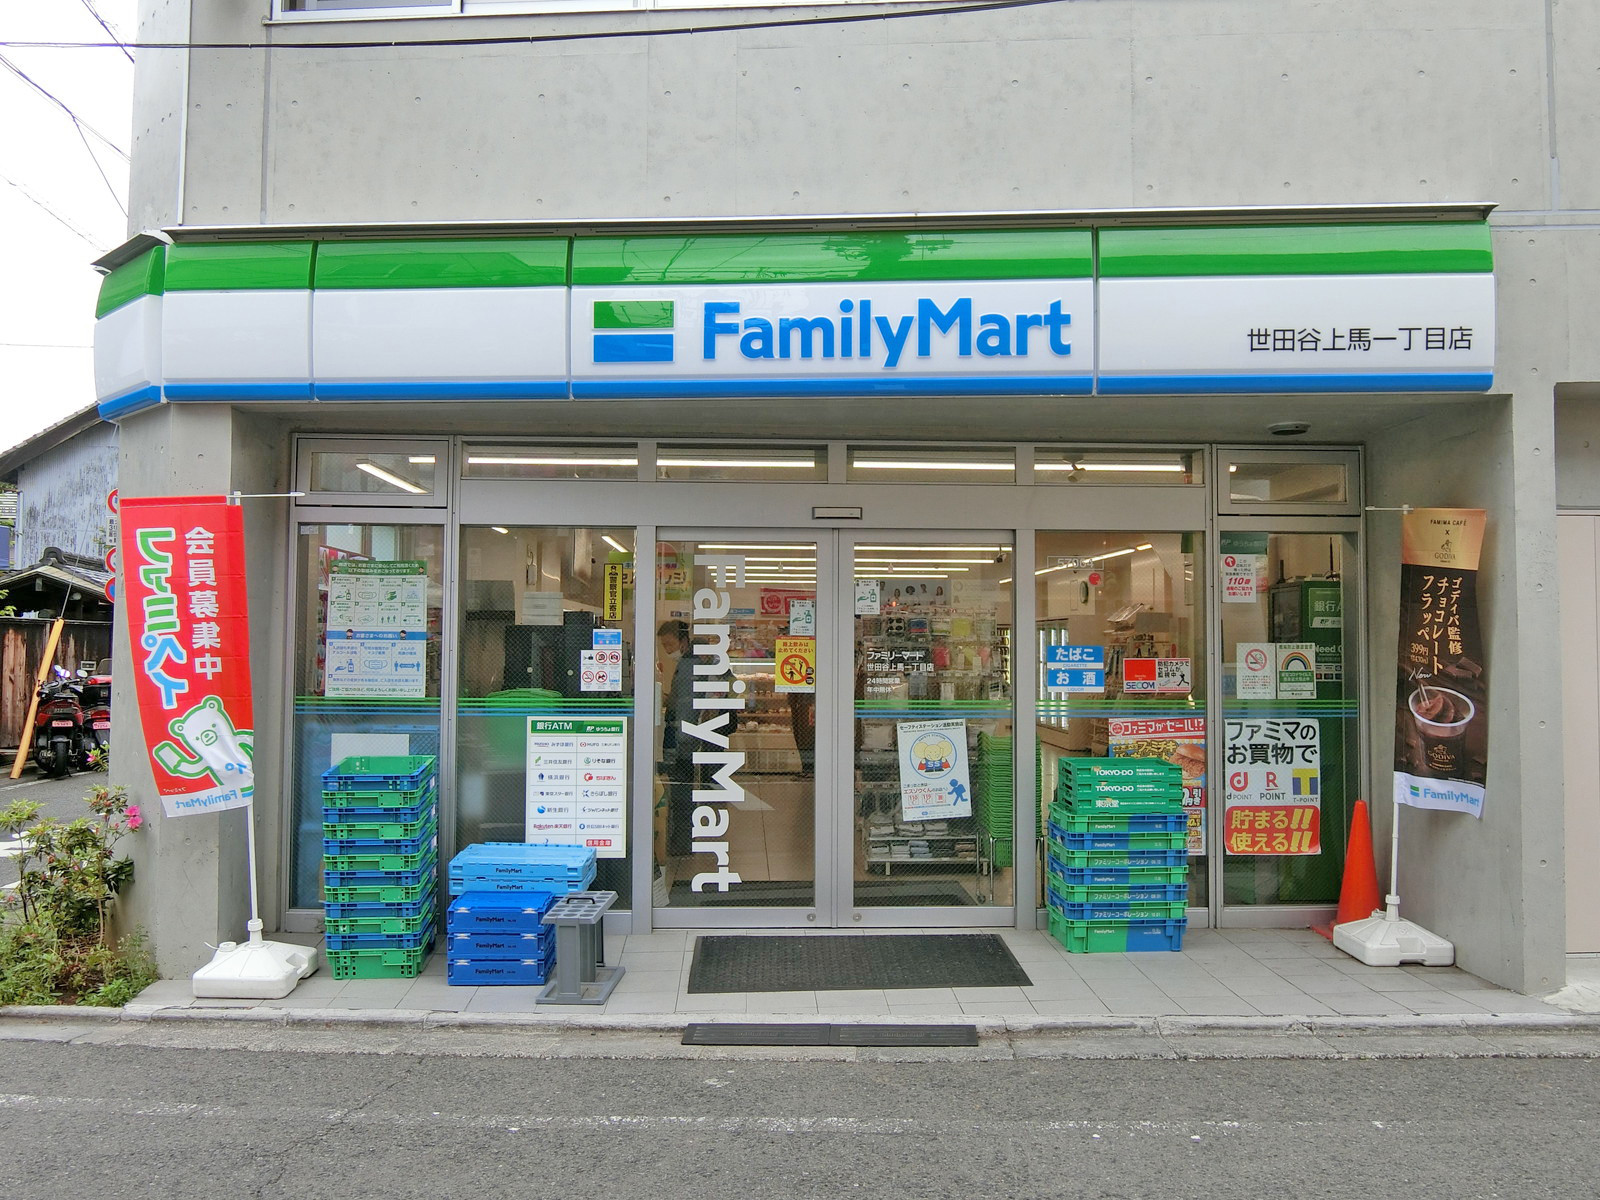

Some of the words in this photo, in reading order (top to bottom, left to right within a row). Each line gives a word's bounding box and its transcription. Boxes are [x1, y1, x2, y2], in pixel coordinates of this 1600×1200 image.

[704, 297, 1072, 368] FamilyMart
[1247, 326, 1473, 352] 世田谷上馬一丁目店
[1417, 575, 1435, 641] フラッペ
[1447, 577, 1463, 655] ゴディバ監修
[1432, 577, 1450, 676] チョコレート
[866, 651, 924, 660] ファミリーマート
[1056, 647, 1095, 661] たばこ
[1410, 643, 1428, 656] 399円
[867, 663, 935, 672] 世田谷上馬一丁目店
[1126, 681, 1155, 689] SECOM
[536, 722, 573, 730] 銀行ATM
[681, 554, 746, 892] FamilyMart
[1227, 720, 1317, 742] ファミマの
[1137, 741, 1177, 753] ファミチキ
[1227, 743, 1318, 765] お買物で
[1260, 792, 1286, 800] POINT
[1231, 808, 1314, 830] 貯まる!!
[1231, 831, 1313, 853] 使える!!
[1094, 858, 1149, 866] ファミリーコーポレーション
